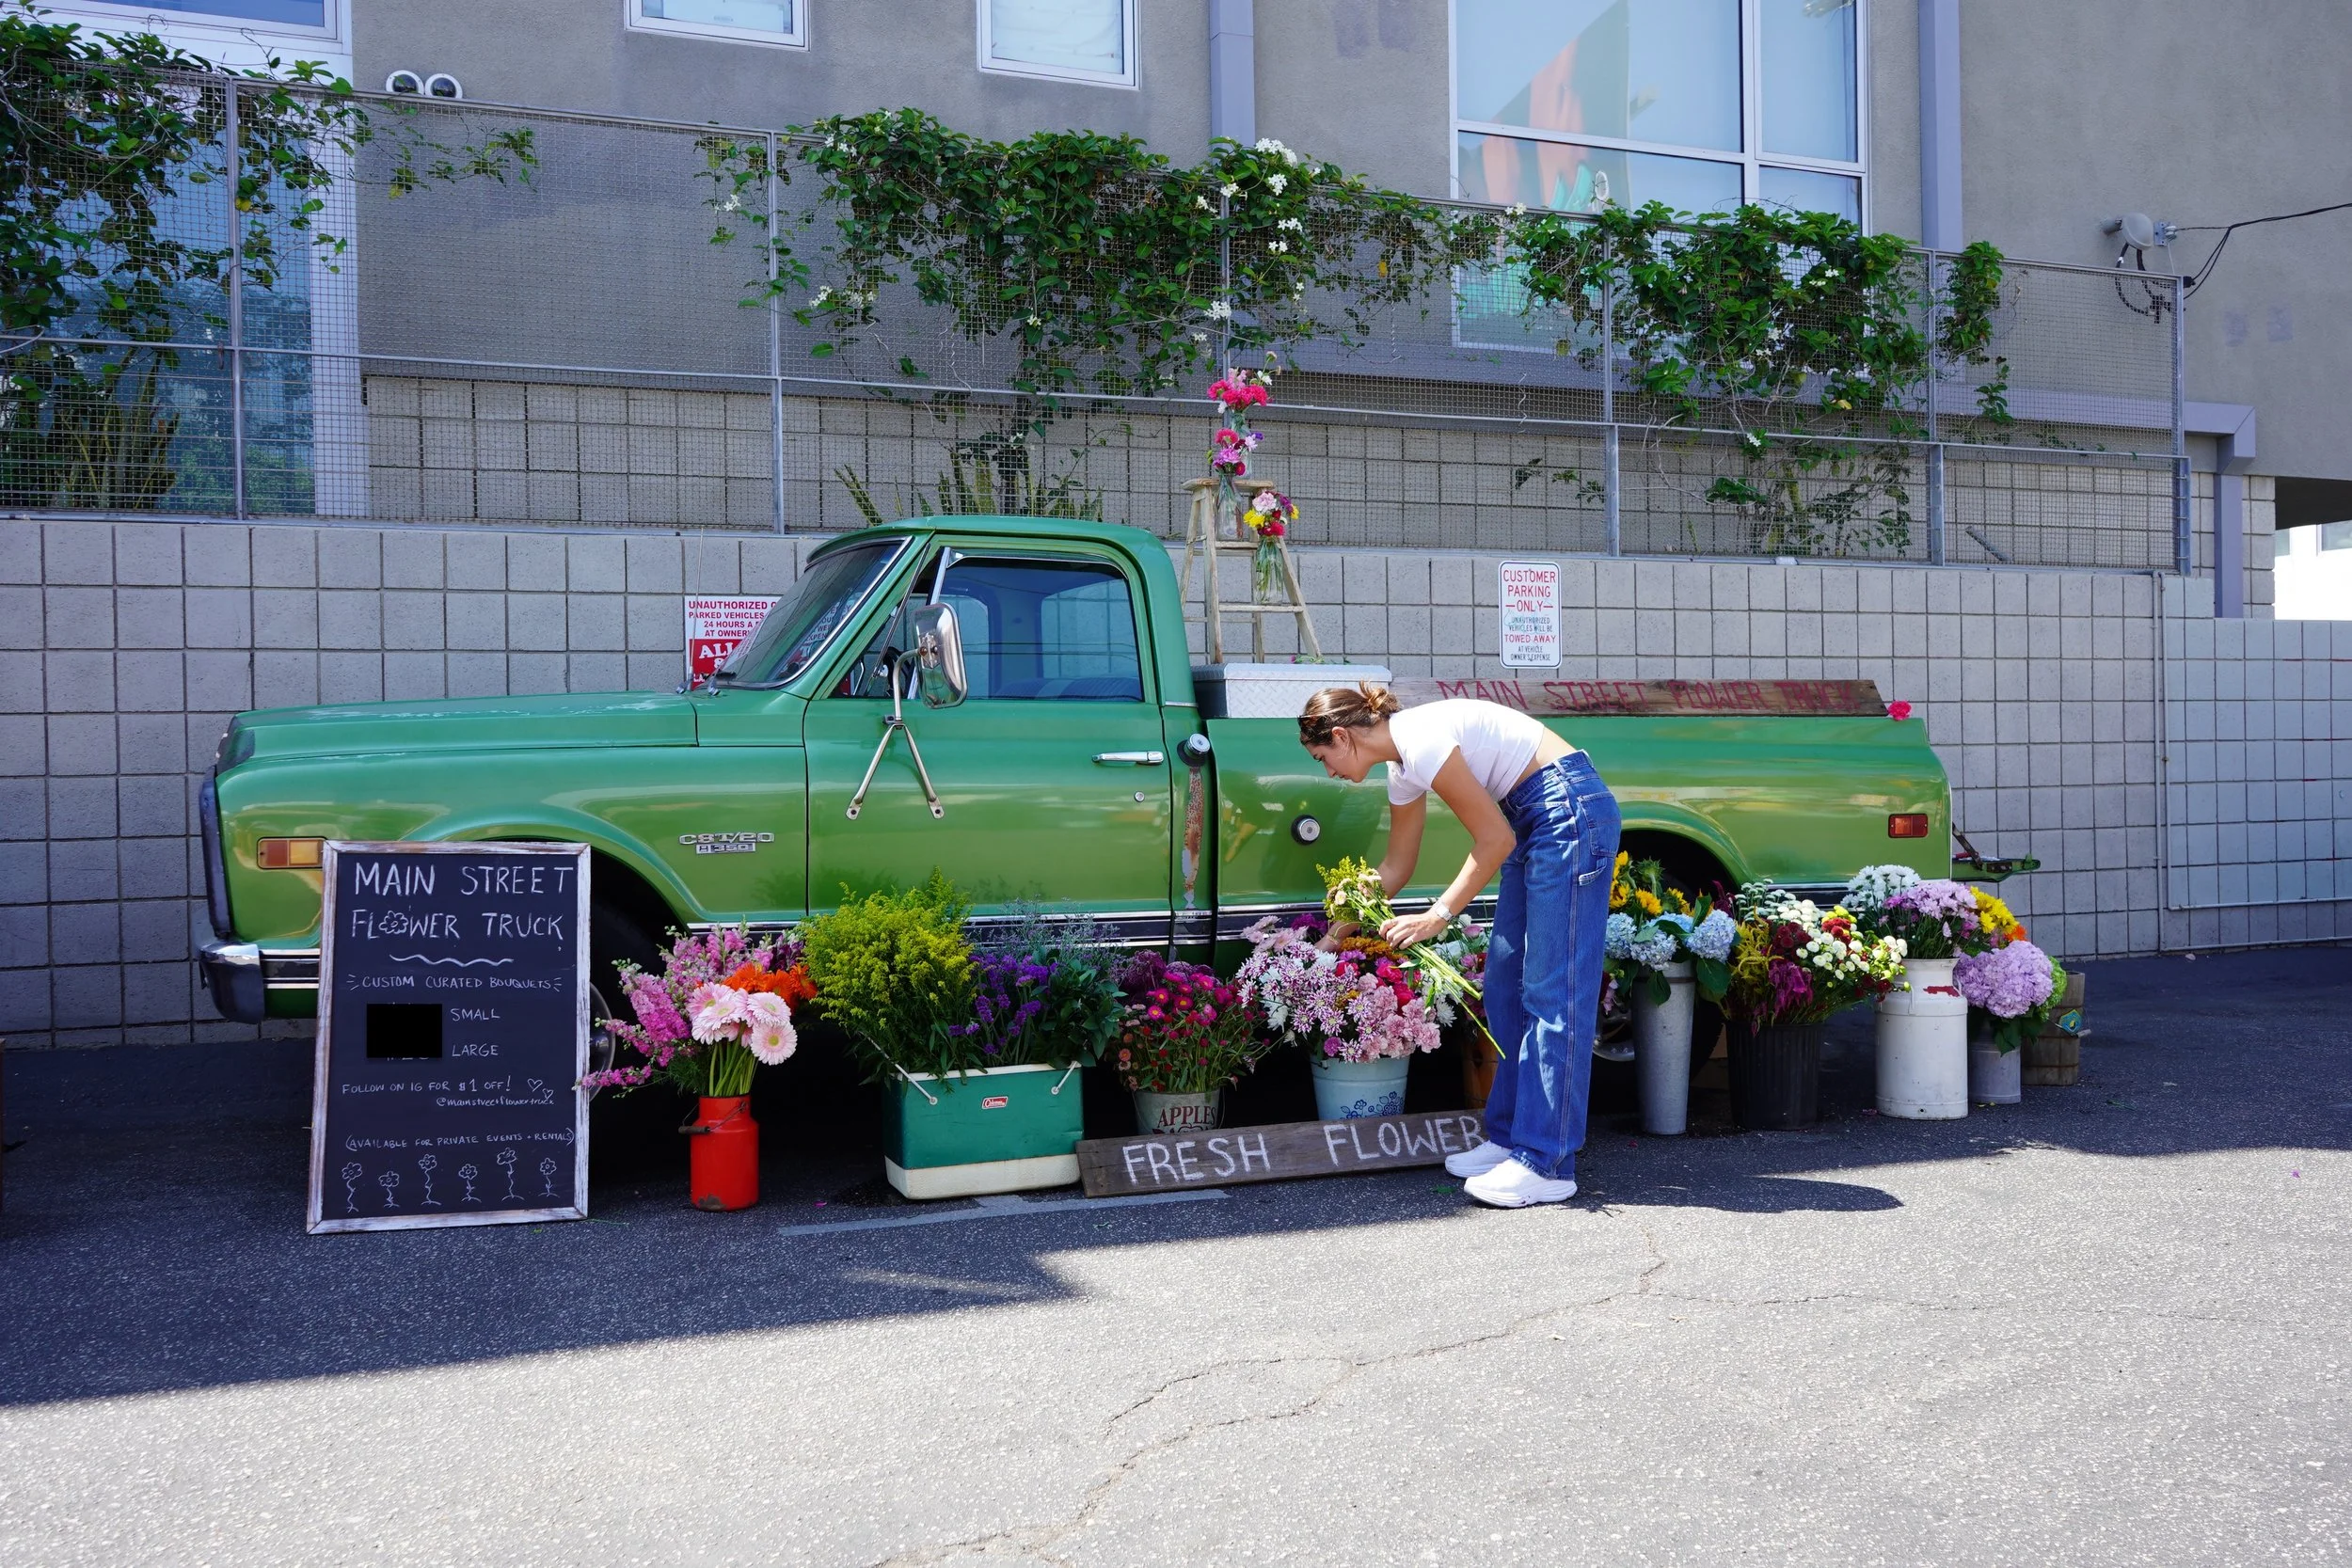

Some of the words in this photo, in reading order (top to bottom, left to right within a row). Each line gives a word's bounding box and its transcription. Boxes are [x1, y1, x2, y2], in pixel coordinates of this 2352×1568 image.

[1503, 569, 1556, 583] CUSTOMER
[1507, 585, 1550, 598] PARKING
[689, 601, 768, 610] UNAUTHORIZED
[1505, 634, 1531, 643] TOWED
[1534, 634, 1556, 643] AWAY
[1436, 680, 1529, 710] MAIN
[1543, 681, 1646, 711] STREET
[1667, 680, 1772, 710] FLOWER
[1773, 681, 1861, 711] TRUCK
[355, 862, 436, 895] MAIN
[460, 865, 574, 895] STREET
[482, 912, 564, 941] TRUCK
[362, 975, 415, 989] CUSTOM
[425, 975, 482, 989] CURATED
[489, 976, 551, 990] BOUQUETS
[450, 1007, 501, 1022] SMALL
[452, 1043, 500, 1057] LARGE
[342, 1084, 385, 1094] FOLLOW
[389, 1083, 405, 1092] ON
[410, 1083, 422, 1092] IG
[428, 1082, 450, 1091] FOR
[484, 1075, 511, 1092] OFF!
[1157, 1105, 1216, 1128] APPLES
[345, 1134, 407, 1151] (AVAILABLE
[415, 1137, 433, 1147] FOR
[437, 1135, 480, 1146] PRIVATE
[486, 1133, 523, 1142] EVENTS
[1121, 1132, 1272, 1187] FRESH
[1323, 1116, 1485, 1167] FLOWER
